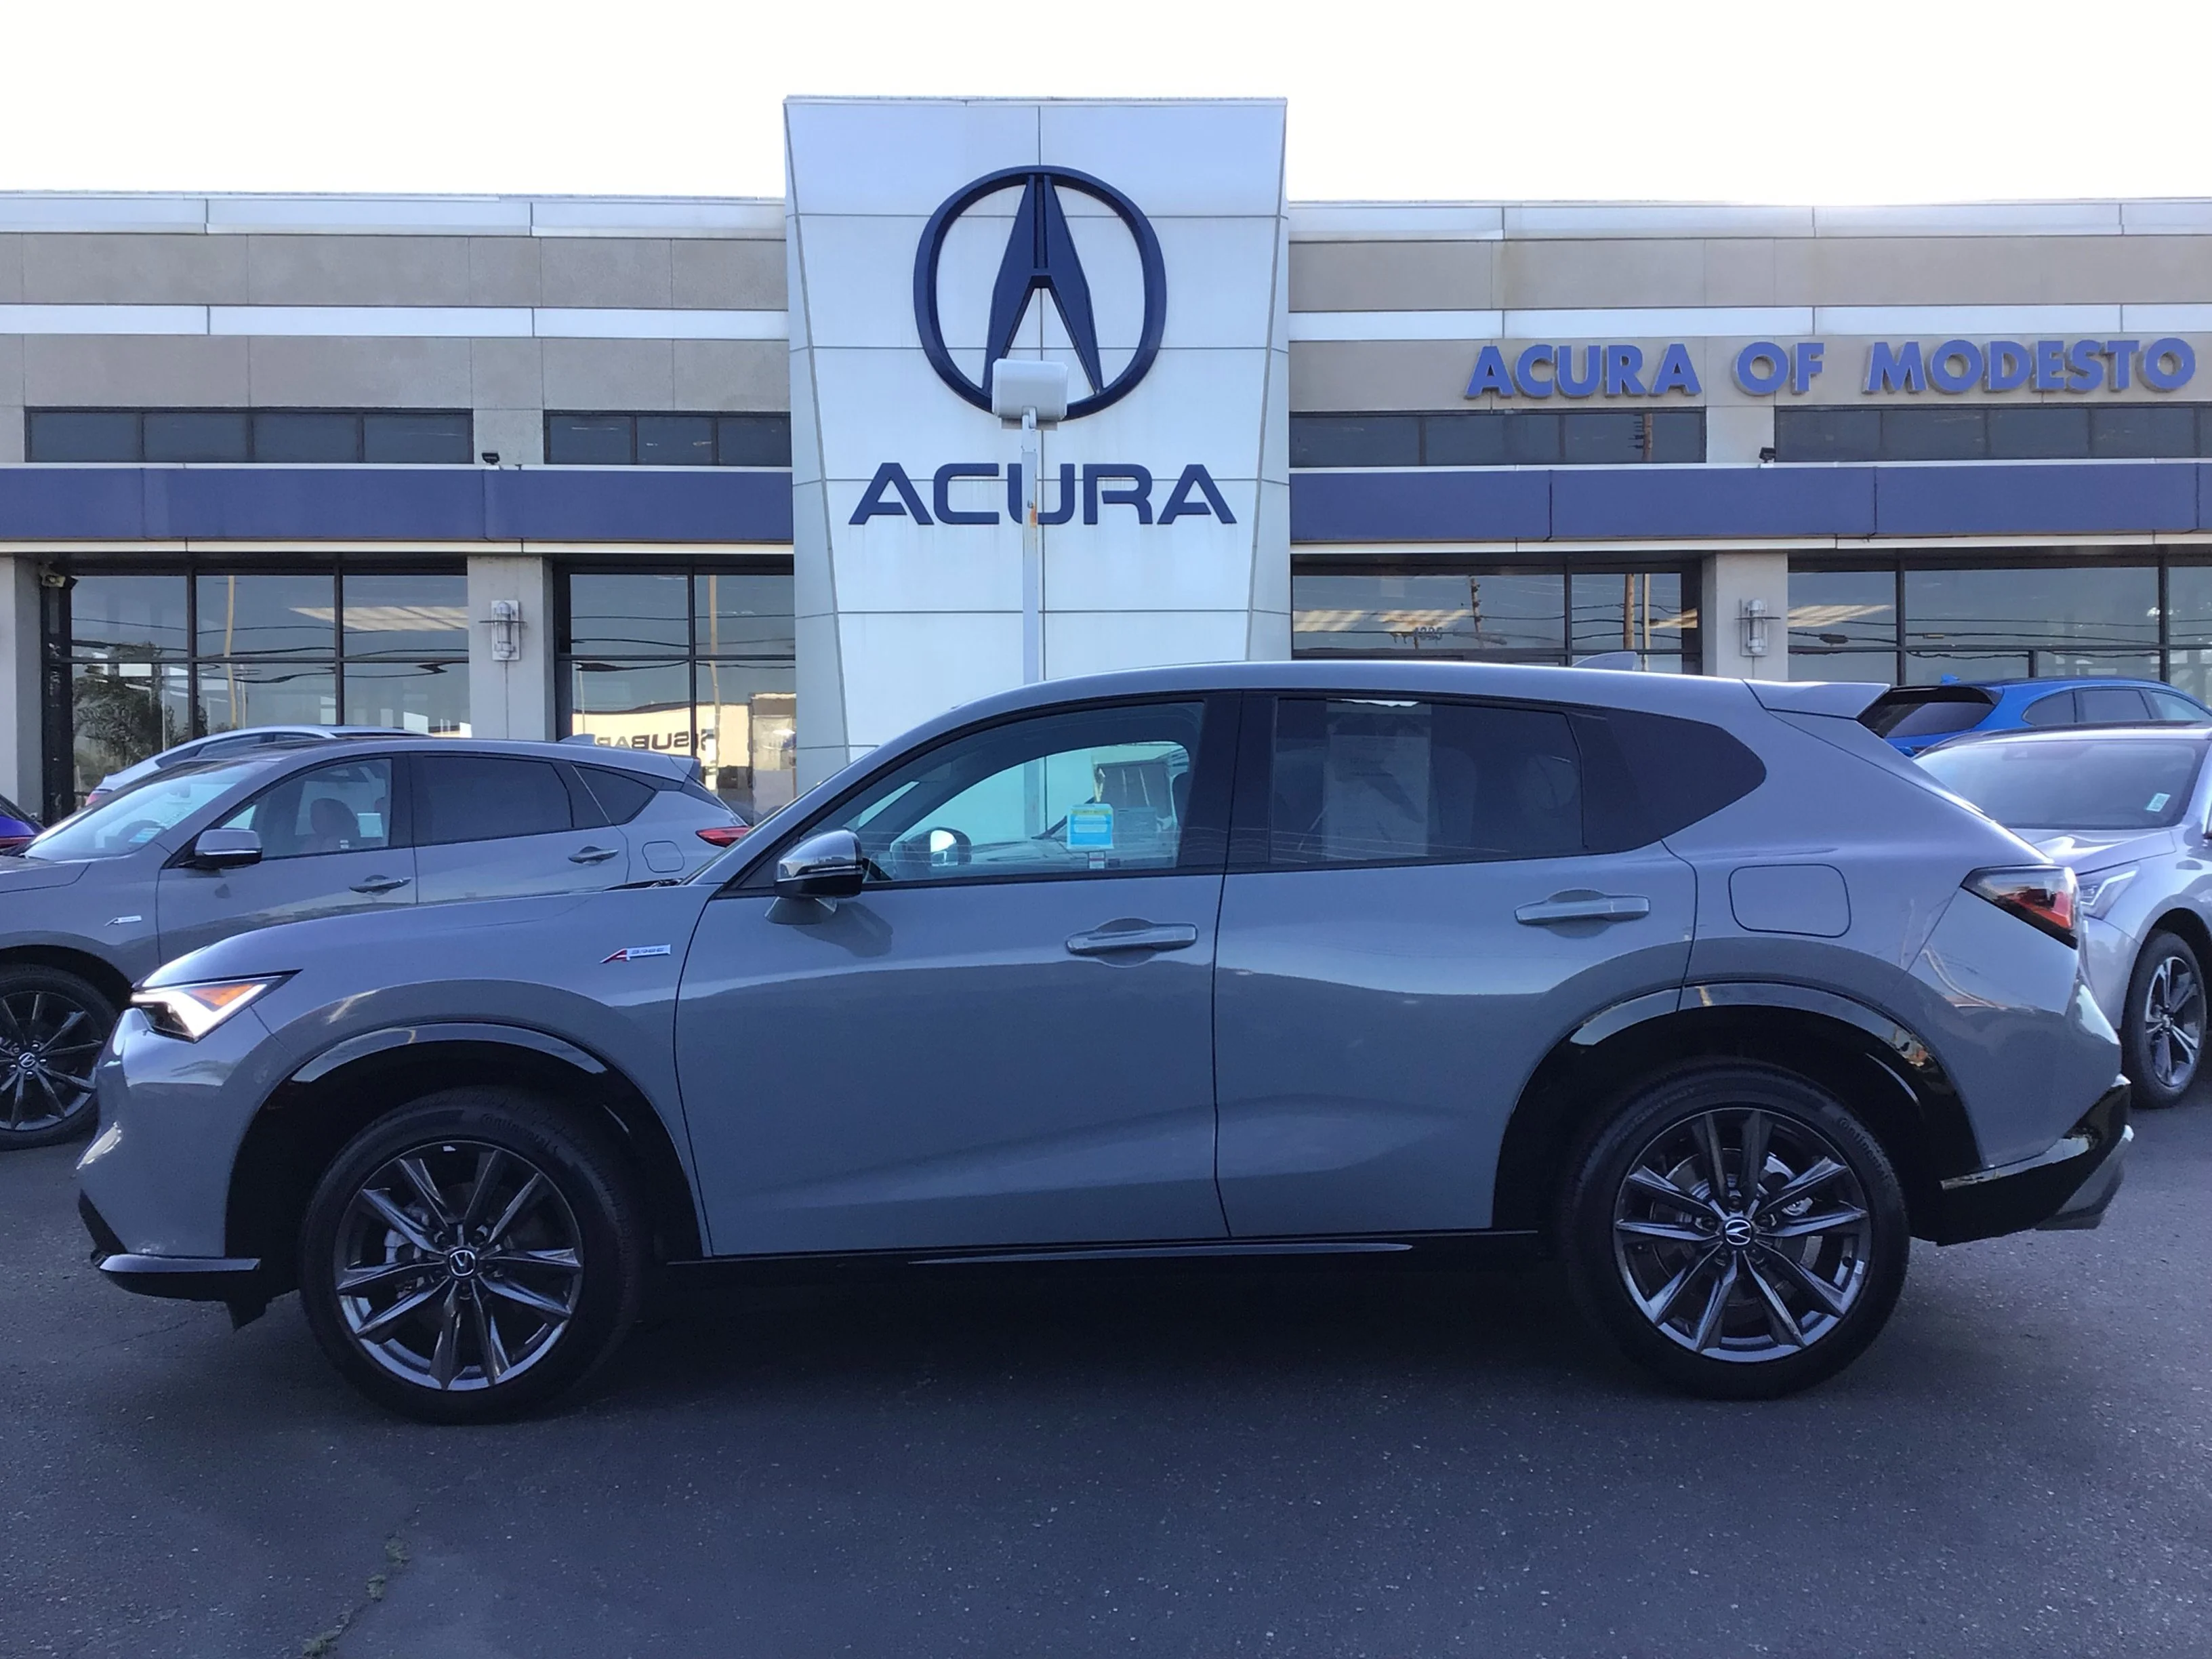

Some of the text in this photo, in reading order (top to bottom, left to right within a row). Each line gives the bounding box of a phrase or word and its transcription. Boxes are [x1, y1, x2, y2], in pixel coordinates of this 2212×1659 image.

[1466, 337, 2196, 397] ACURA OF MODESTO
[848, 462, 1237, 525] ACURA
